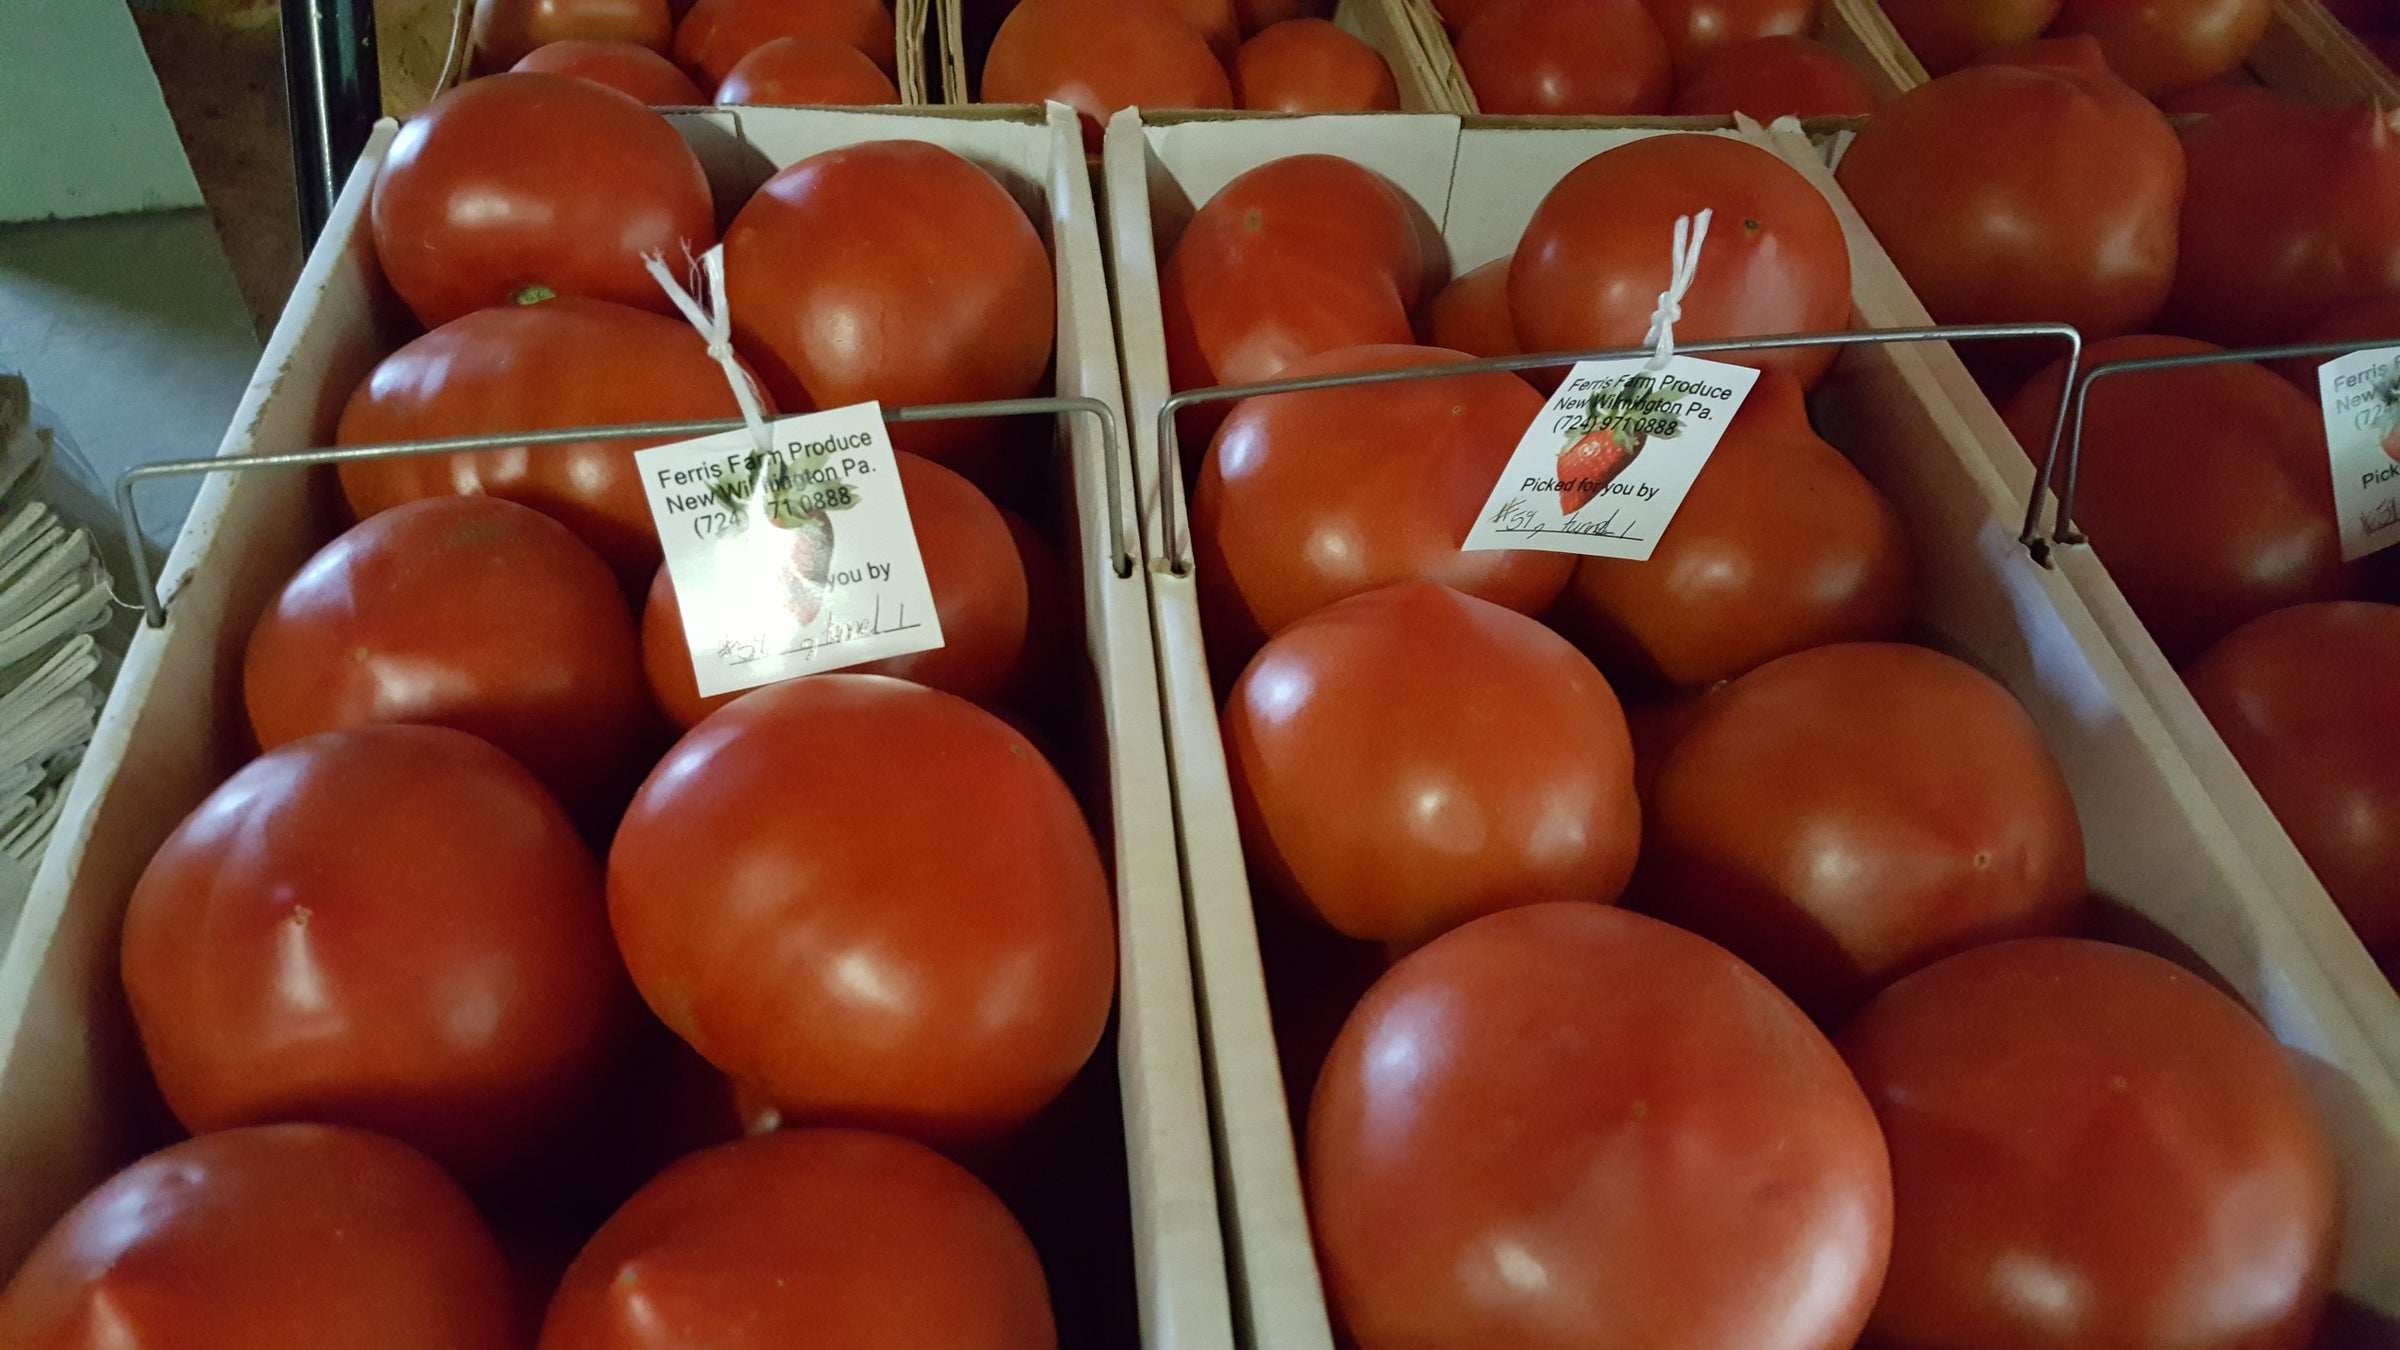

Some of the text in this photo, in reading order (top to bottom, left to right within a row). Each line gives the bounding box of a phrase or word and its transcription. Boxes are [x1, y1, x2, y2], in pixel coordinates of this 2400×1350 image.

[1567, 374, 1733, 401] Ferris Farm Produce
[2334, 363, 2389, 393] Ferris
[1553, 393, 1713, 420] New Wilmington Pa.
[2336, 390, 2375, 414] New
[1553, 415, 1679, 436] (724) 971 0888
[657, 432, 873, 489] Ferris Farm Produce
[666, 488, 716, 514] New
[842, 457, 877, 477] Pa.
[1520, 477, 1660, 502] Picked for you by
[800, 486, 851, 513] 0888
[827, 561, 892, 593] you by
